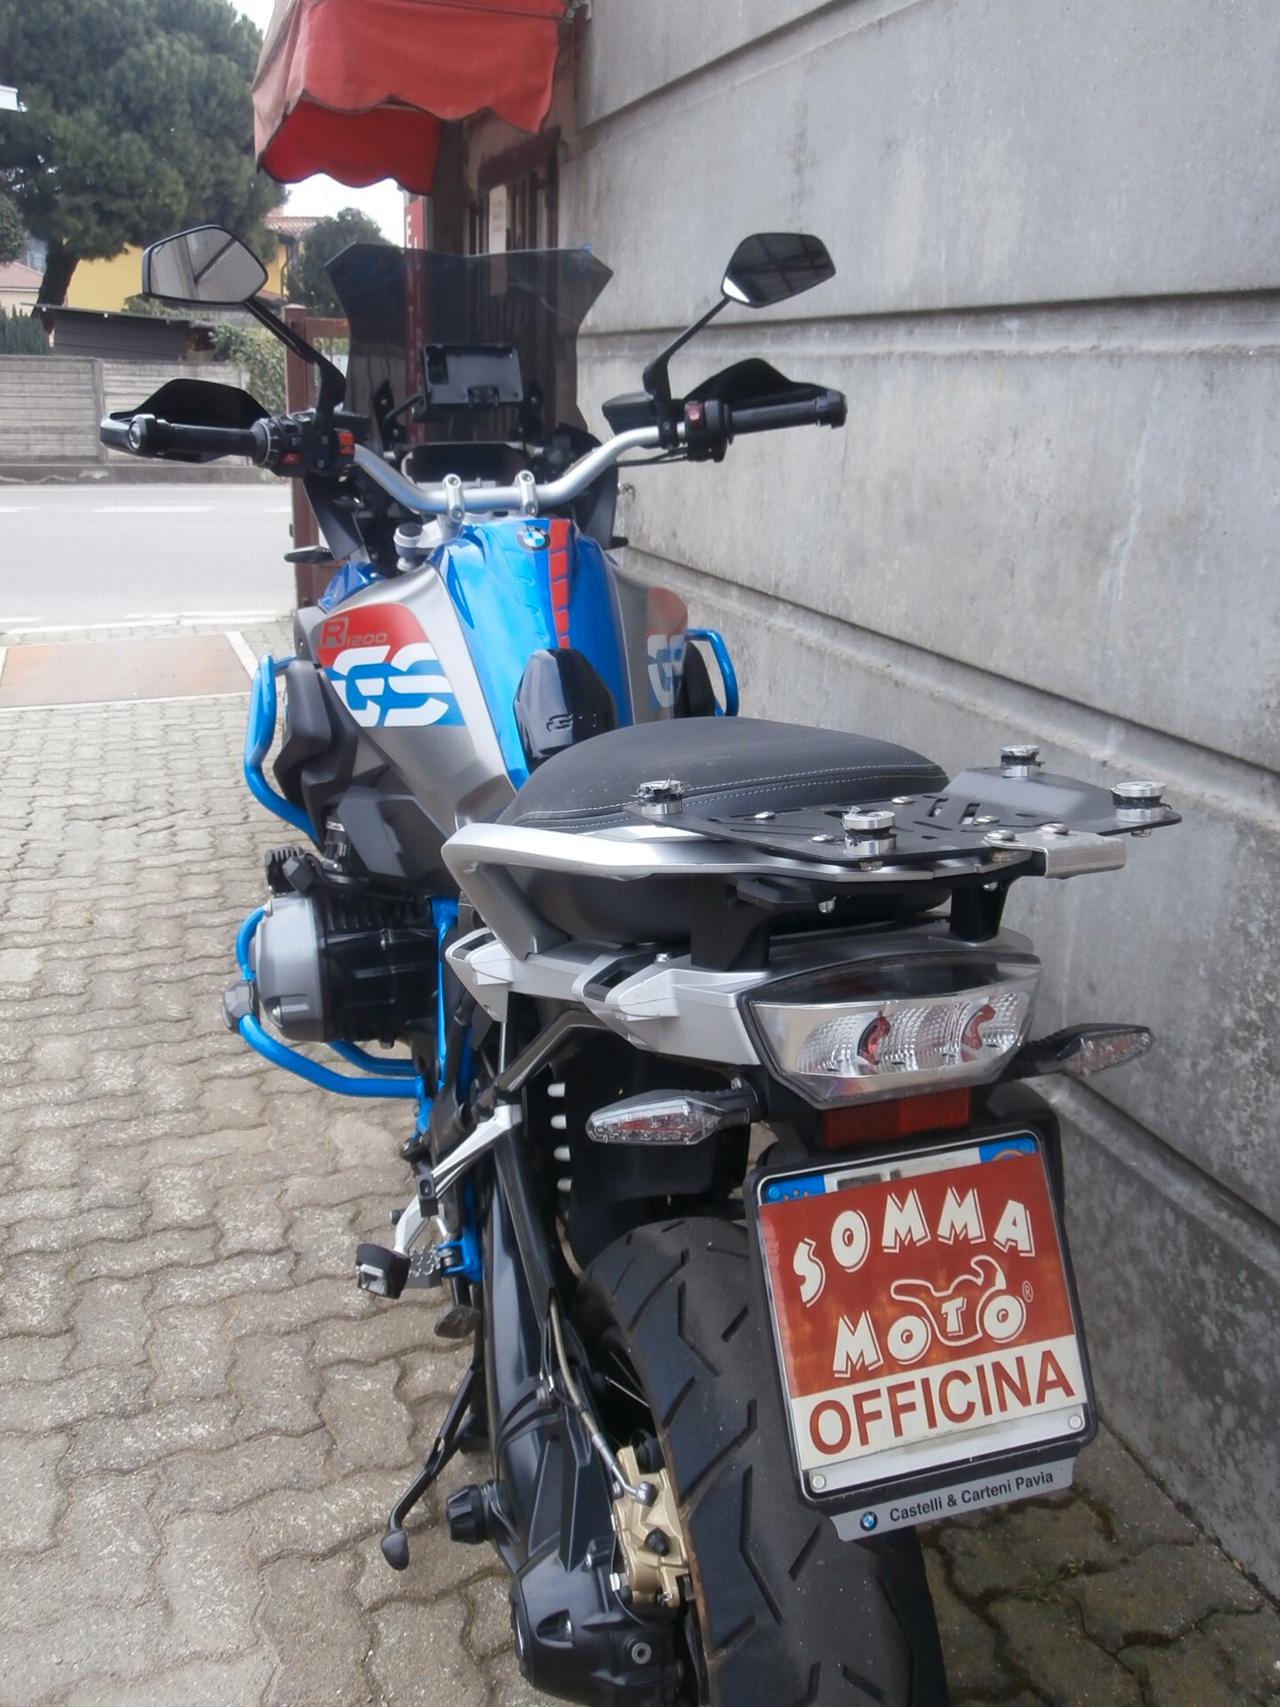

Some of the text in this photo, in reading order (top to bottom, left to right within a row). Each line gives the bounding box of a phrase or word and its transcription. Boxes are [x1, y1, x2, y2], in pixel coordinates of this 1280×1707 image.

[793, 1185, 1036, 1307] SOMMA
[809, 1350, 1076, 1455] OFFICINA
[889, 1471, 1054, 1522] Castelli & Carteni Pavia
